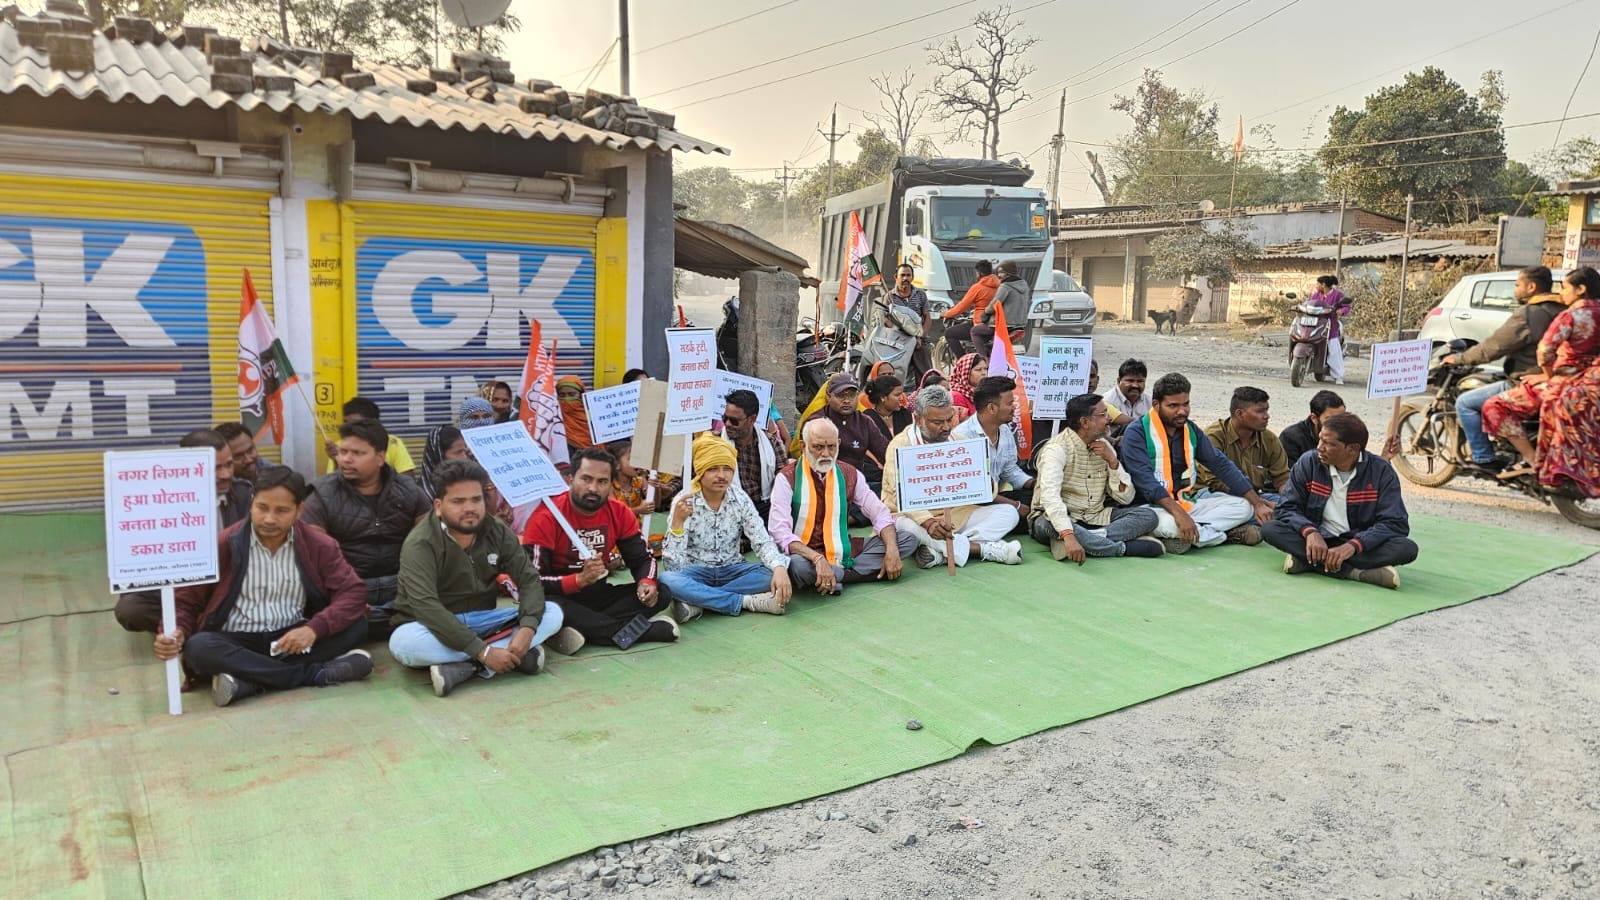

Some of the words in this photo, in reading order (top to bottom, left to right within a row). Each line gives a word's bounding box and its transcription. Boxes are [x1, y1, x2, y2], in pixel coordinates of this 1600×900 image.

[371, 250, 583, 350] GK
[320, 387, 328, 401] 3
[118, 470, 148, 482] नगर
[152, 464, 189, 480] निगम
[193, 462, 205, 478] में
[907, 475, 943, 484] भाजपा
[946, 470, 982, 480] सरकार
[123, 494, 148, 512] हुआ
[118, 519, 156, 531] जनता
[160, 518, 178, 529] का
[181, 512, 206, 527] पैसा
[130, 543, 164, 556] डकार
[168, 540, 196, 552] डाला
